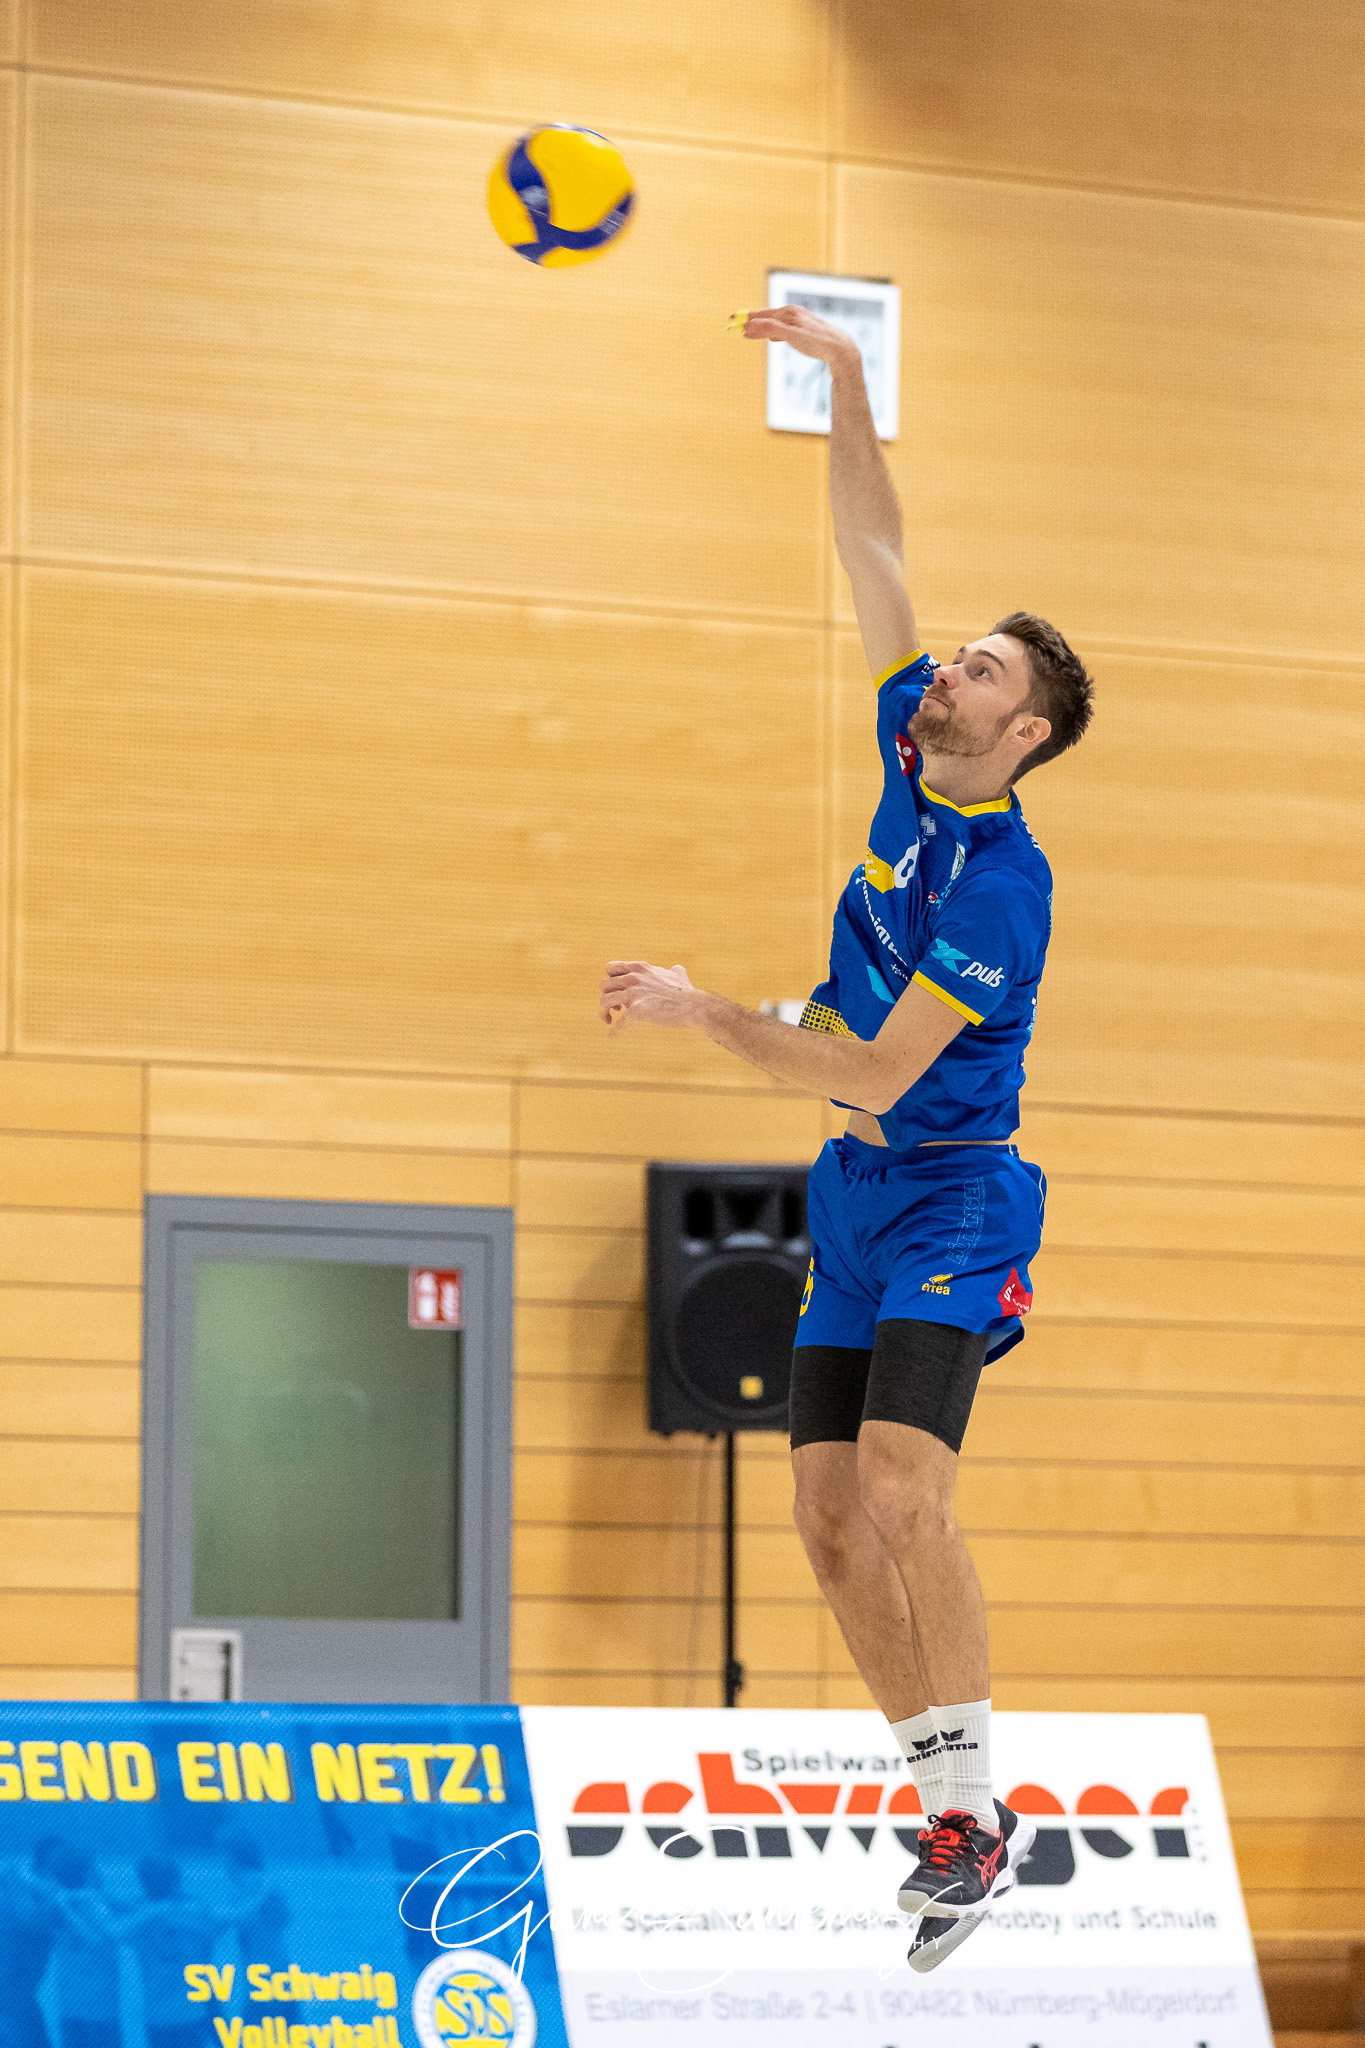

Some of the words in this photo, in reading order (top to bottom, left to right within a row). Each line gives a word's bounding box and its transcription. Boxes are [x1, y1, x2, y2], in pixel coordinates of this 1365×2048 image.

[959, 961, 1005, 988] puls
[742, 1748, 901, 1778] Spielwar
[906, 1747, 942, 1763] erim
[178, 1741, 290, 1802] EIN
[311, 1742, 506, 1803] NETZ!
[1072, 1904, 1121, 1928] und
[1131, 1903, 1218, 1928] Schule
[184, 1963, 236, 2002] SV
[246, 1963, 398, 2009] Schwaig
[710, 1989, 808, 2021] Straße
[811, 1988, 858, 2019] 2-4
